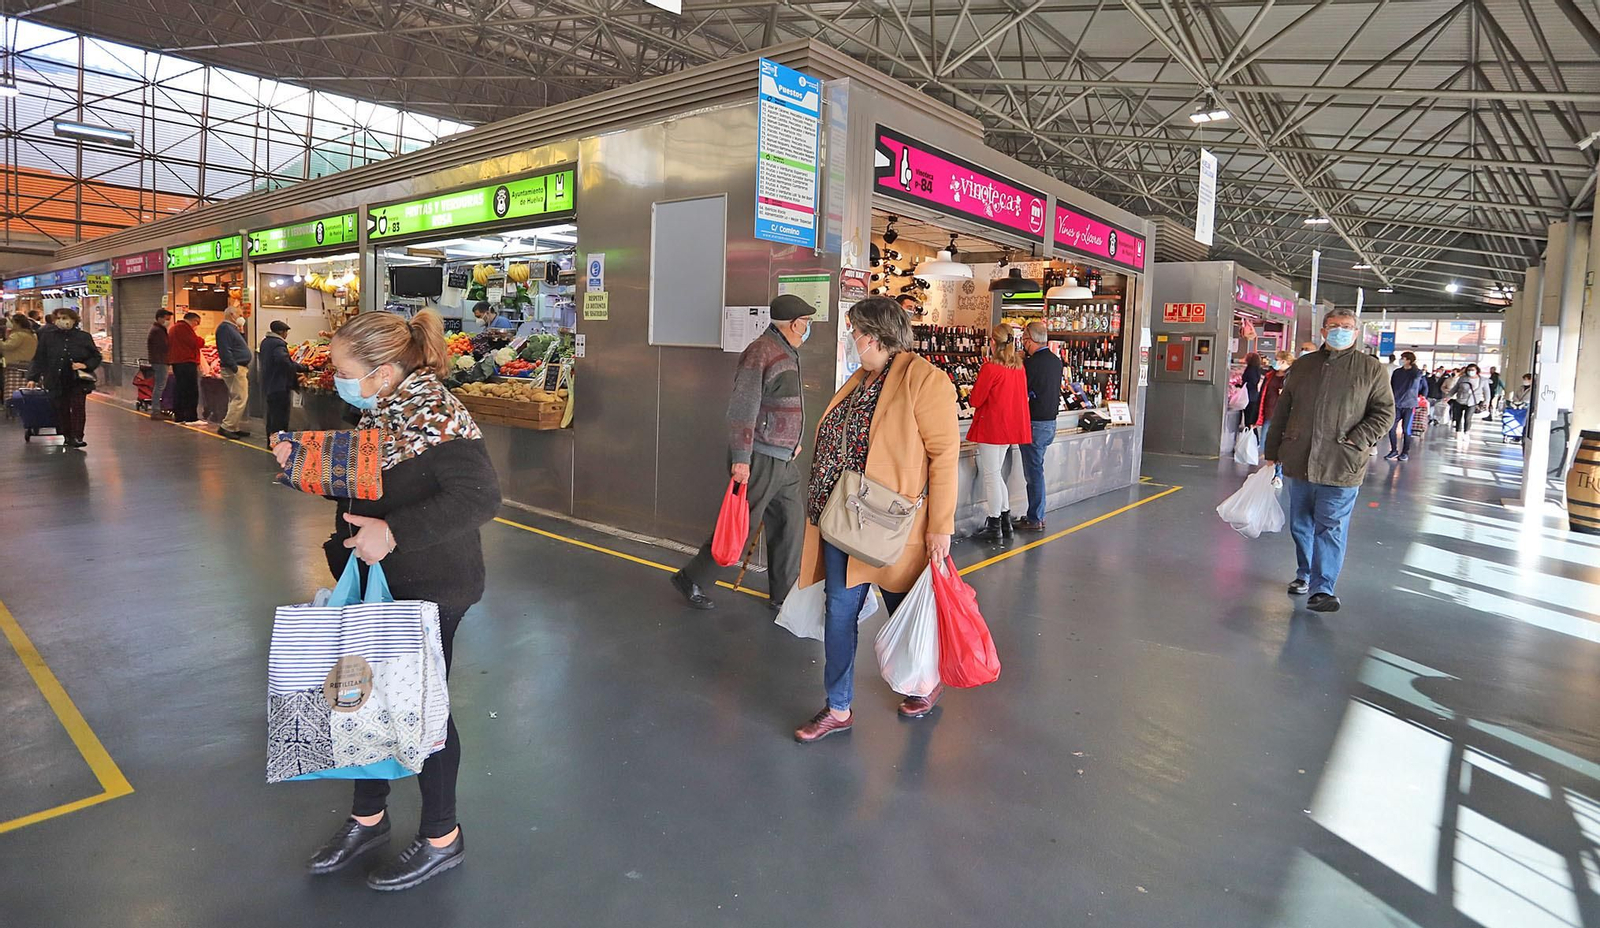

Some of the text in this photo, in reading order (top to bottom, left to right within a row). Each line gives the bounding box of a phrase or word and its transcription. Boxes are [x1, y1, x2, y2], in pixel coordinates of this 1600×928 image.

[778, 84, 803, 98] Puestos
[916, 169, 933, 180] Vinoteca
[512, 188, 544, 199] Ayuntamiento
[960, 175, 1014, 212] vinoteca
[527, 197, 543, 205] Huelva
[392, 222, 400, 232] 83
[771, 224, 800, 236] C/ Comino
[1058, 215, 1075, 237] Vinos
[1082, 224, 1104, 246] Licores
